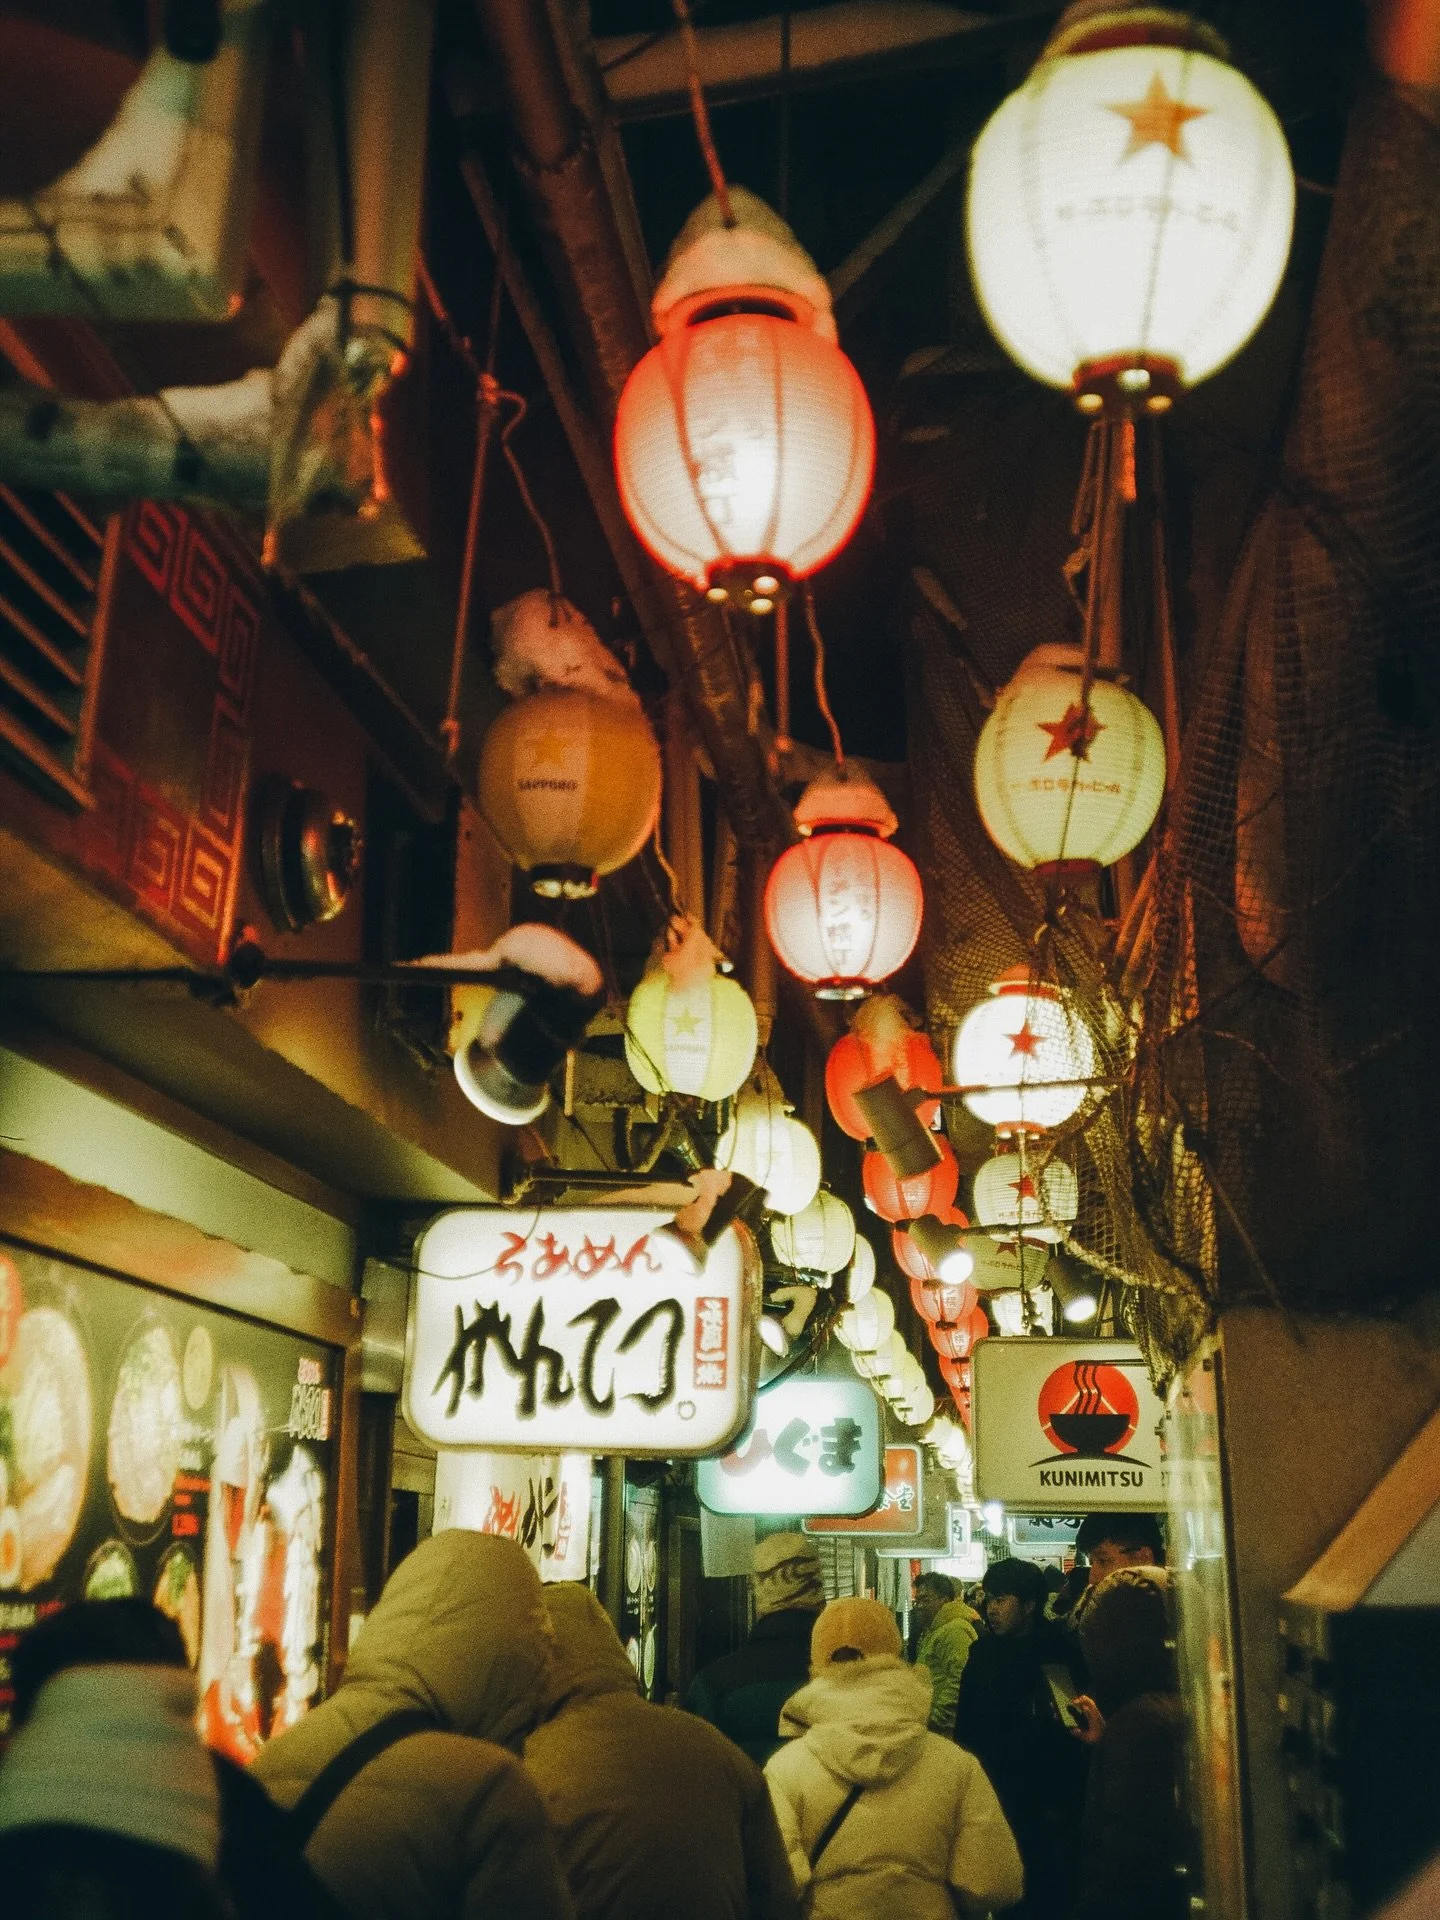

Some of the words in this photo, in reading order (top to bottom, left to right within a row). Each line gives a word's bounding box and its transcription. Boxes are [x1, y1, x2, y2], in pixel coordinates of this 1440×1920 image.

[517, 778, 579, 792] SAPPORO
[494, 1230, 662, 1286] らあめん
[1039, 1469, 1144, 1488] KUNIMITSU
